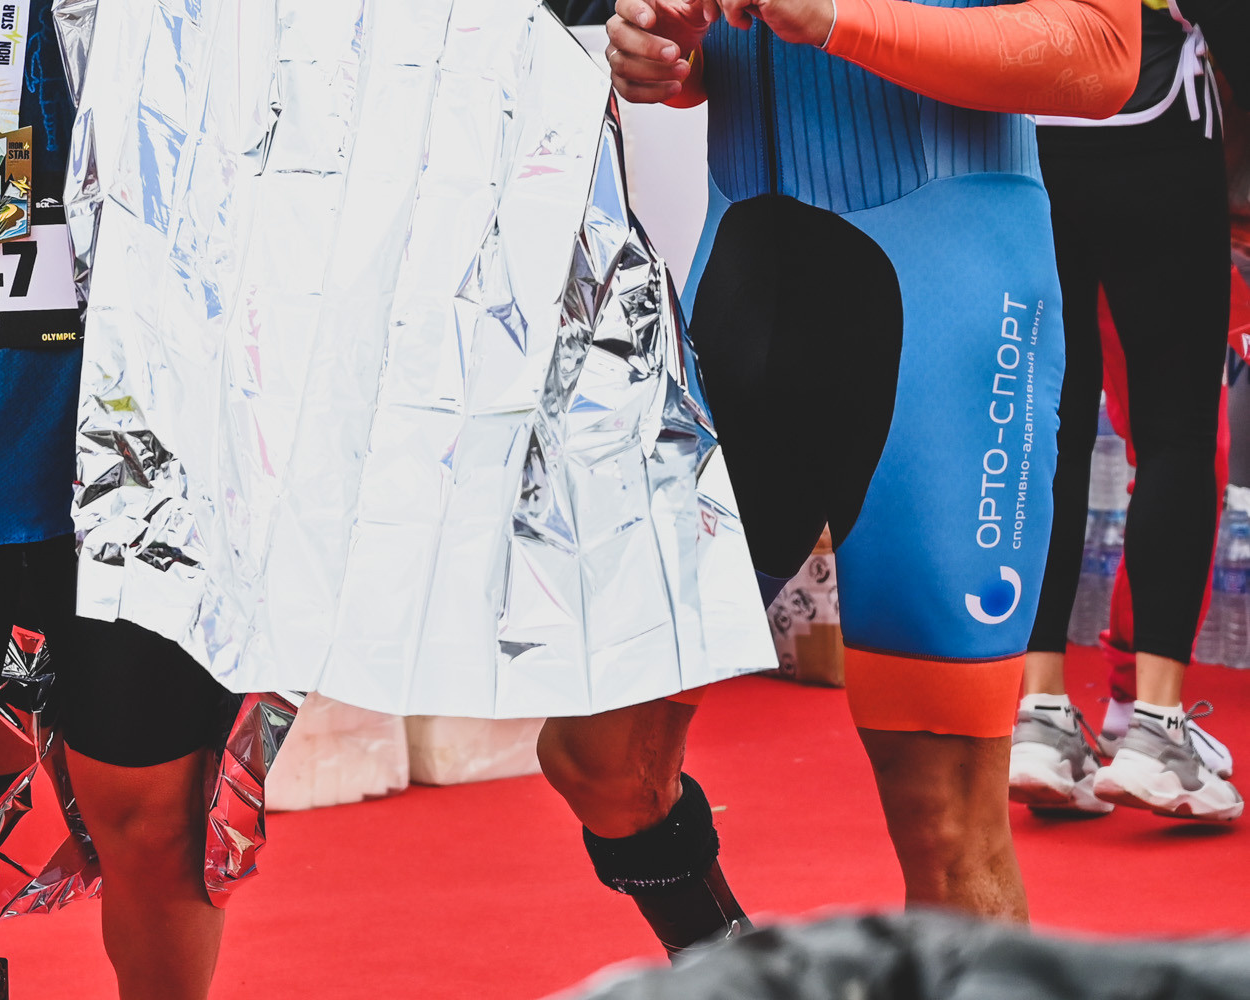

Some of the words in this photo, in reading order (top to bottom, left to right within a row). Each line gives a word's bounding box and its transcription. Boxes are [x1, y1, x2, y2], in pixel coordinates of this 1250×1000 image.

[1, 4, 15, 30] STAR
[8, 142, 23, 150] IRON
[8, 150, 30, 160] STAR
[41, 332, 77, 342] OLYMPIC
[976, 291, 1027, 549] ОРТО-СПОРТ
[1012, 351, 1035, 550] спортивно-адаптивный
[1030, 299, 1044, 346] центр
